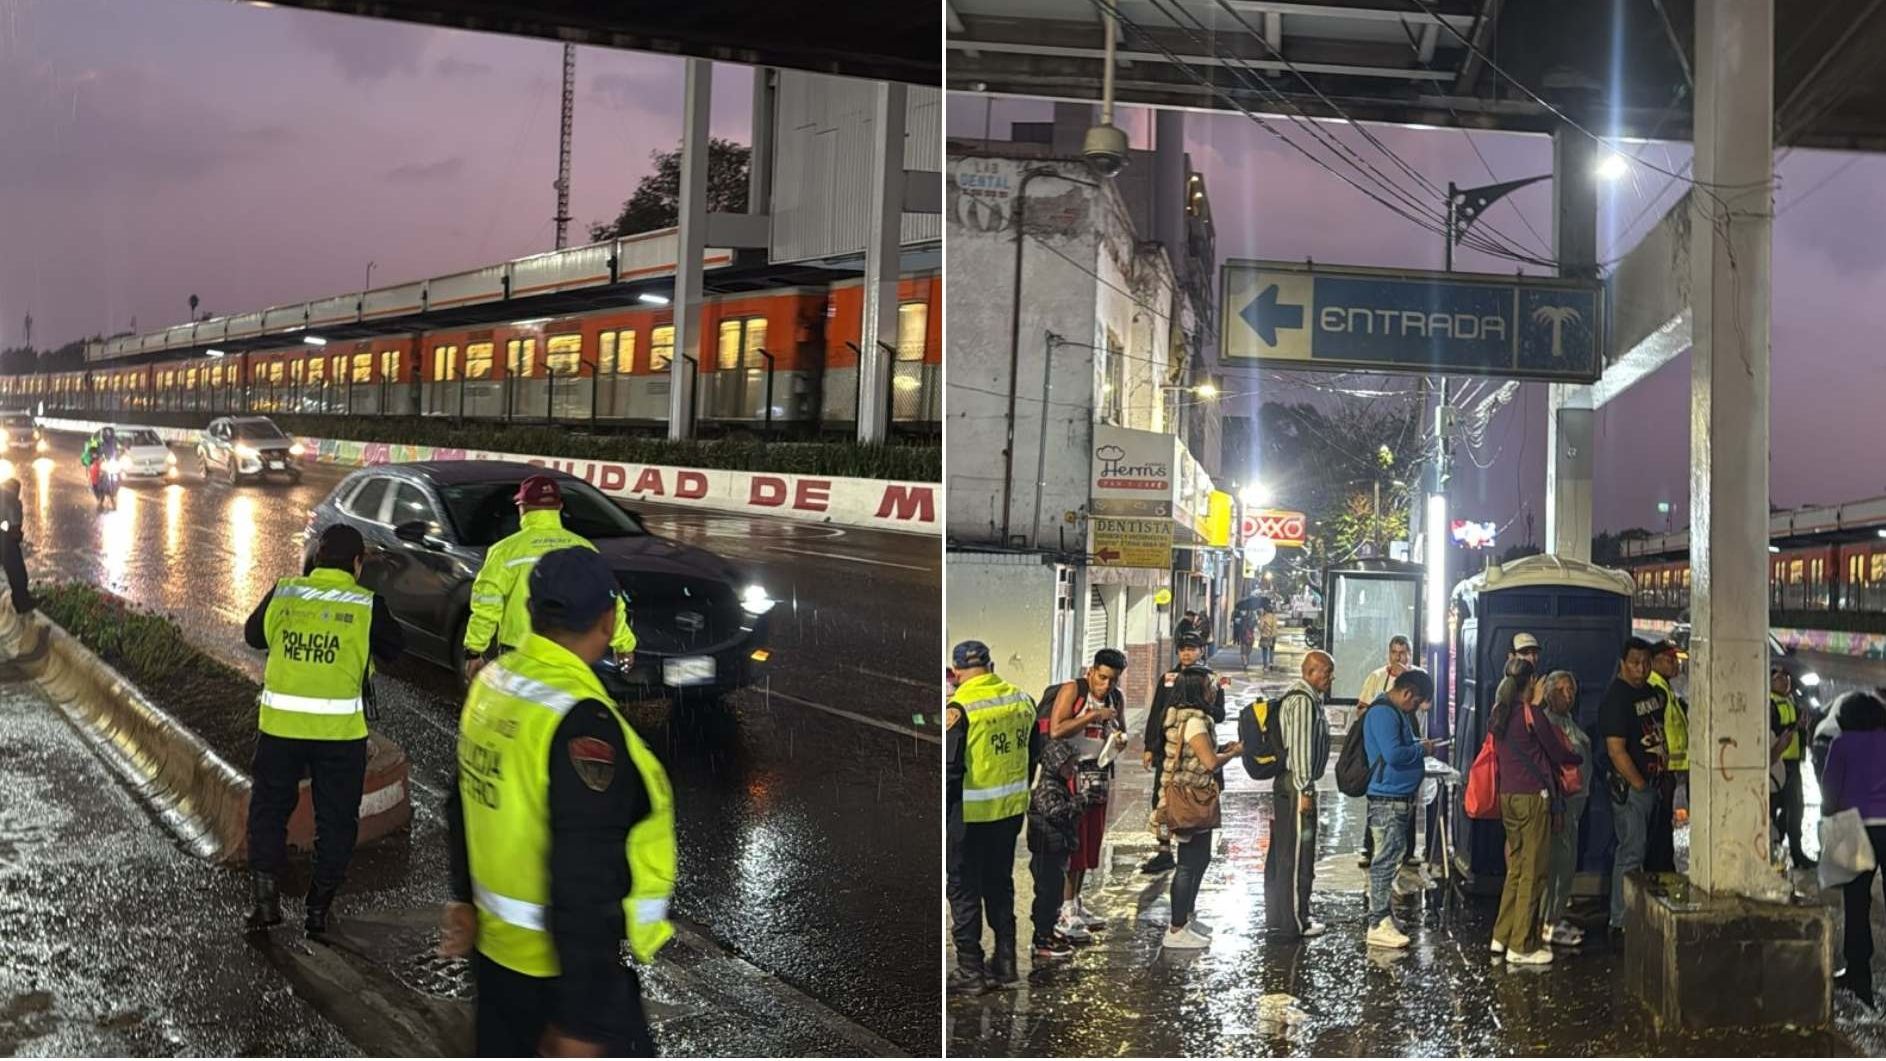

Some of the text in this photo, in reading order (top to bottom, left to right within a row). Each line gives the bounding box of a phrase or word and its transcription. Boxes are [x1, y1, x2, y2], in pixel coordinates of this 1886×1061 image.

[1320, 306, 1506, 342] ENTRADA
[748, 476, 832, 513] DE
[874, 485, 936, 523] M
[1096, 519, 1170, 535] DENTISTA
[1242, 515, 1304, 539] OXXO
[282, 629, 341, 651] POLICÍA
[283, 645, 336, 665] METRO
